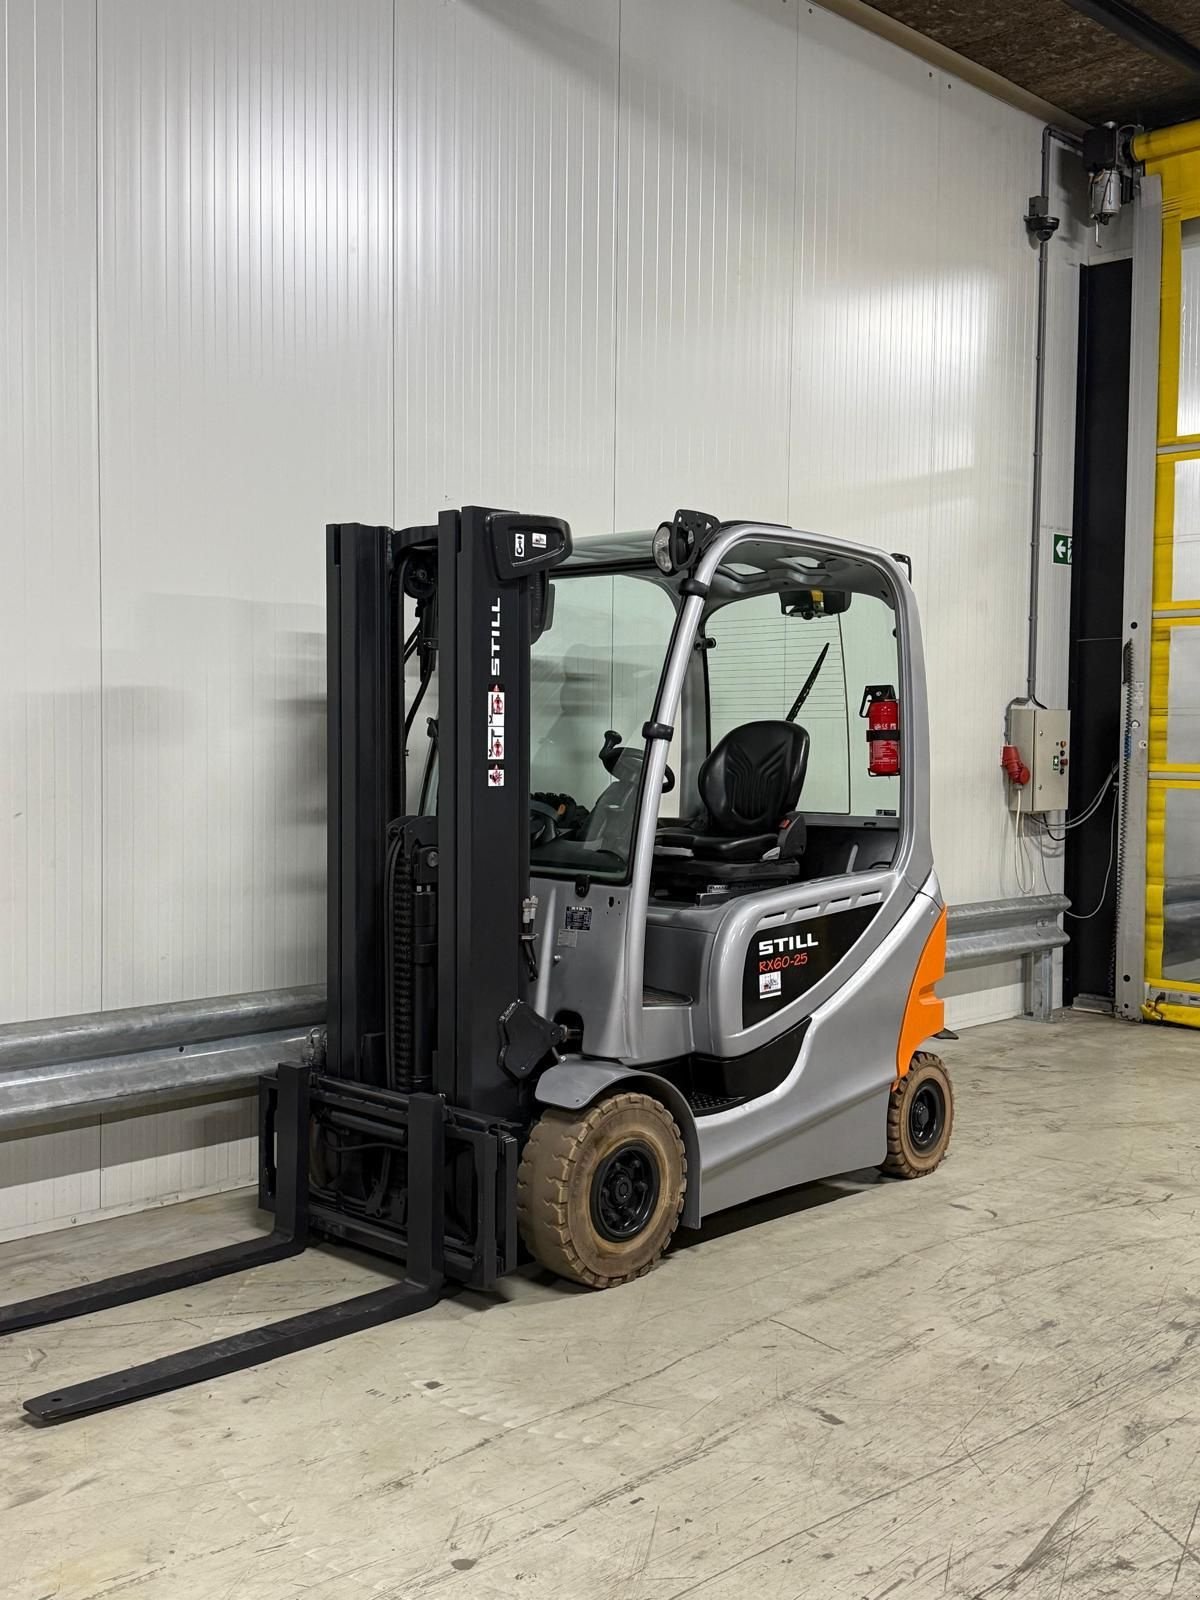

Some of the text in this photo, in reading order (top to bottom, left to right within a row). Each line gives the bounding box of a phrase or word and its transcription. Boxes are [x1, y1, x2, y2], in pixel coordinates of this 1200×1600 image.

[491, 597, 501, 676] STILL
[759, 933, 819, 956] STILL
[759, 952, 808, 972] RX60-25
